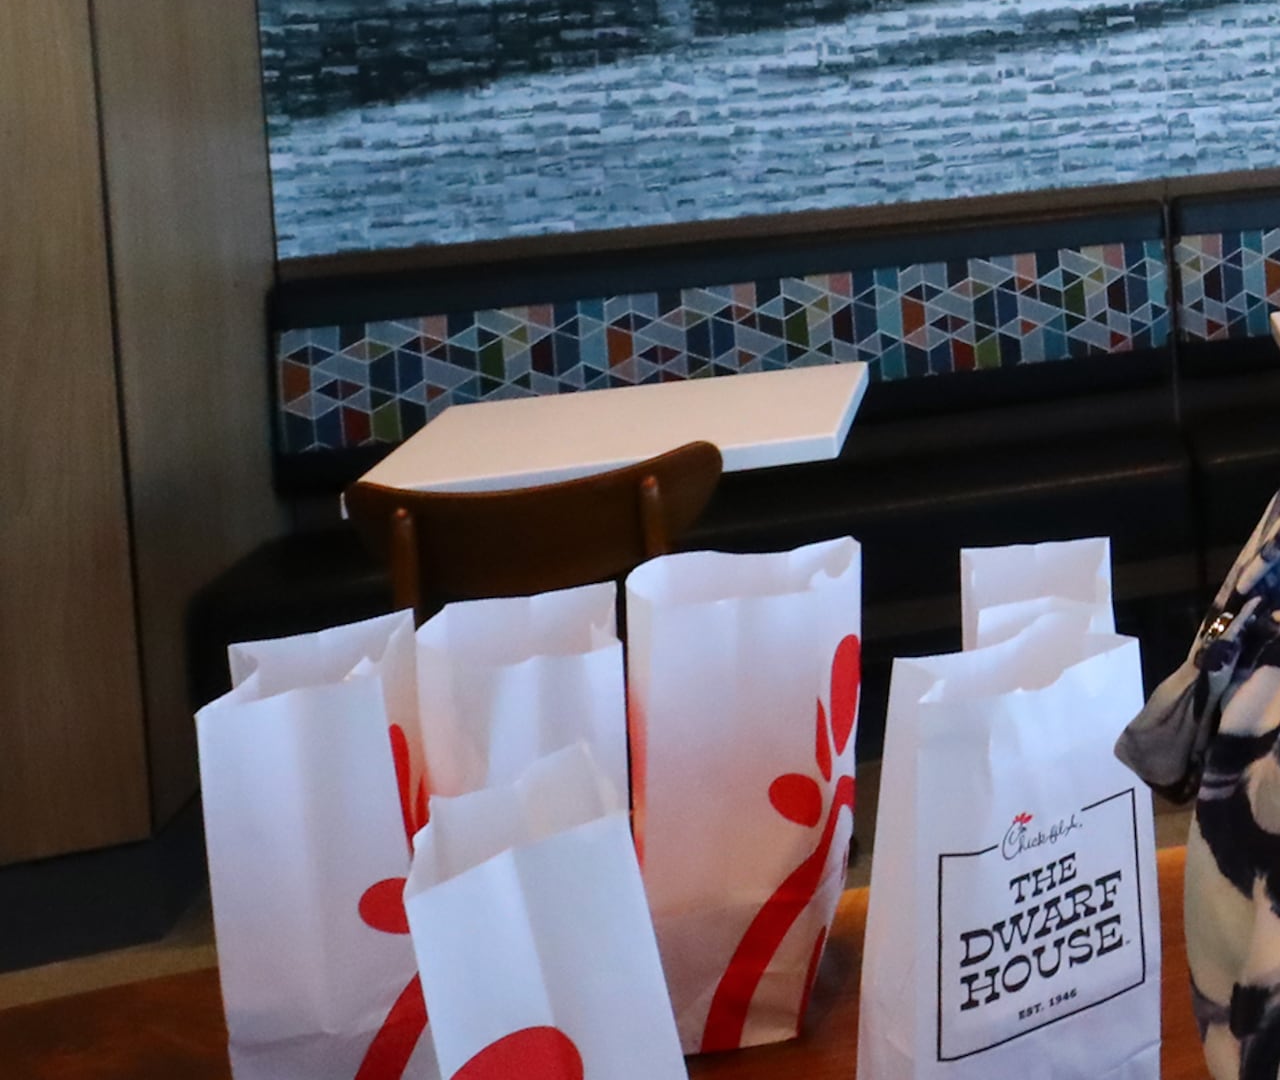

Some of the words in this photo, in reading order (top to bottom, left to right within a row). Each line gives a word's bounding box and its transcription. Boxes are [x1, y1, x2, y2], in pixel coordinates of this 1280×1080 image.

[1009, 852, 1078, 904] THE
[959, 870, 1123, 968] DWARF
[959, 914, 1125, 1013] HOUSE
[1018, 1002, 1044, 1021] EST.
[1049, 987, 1078, 1007] 1946
